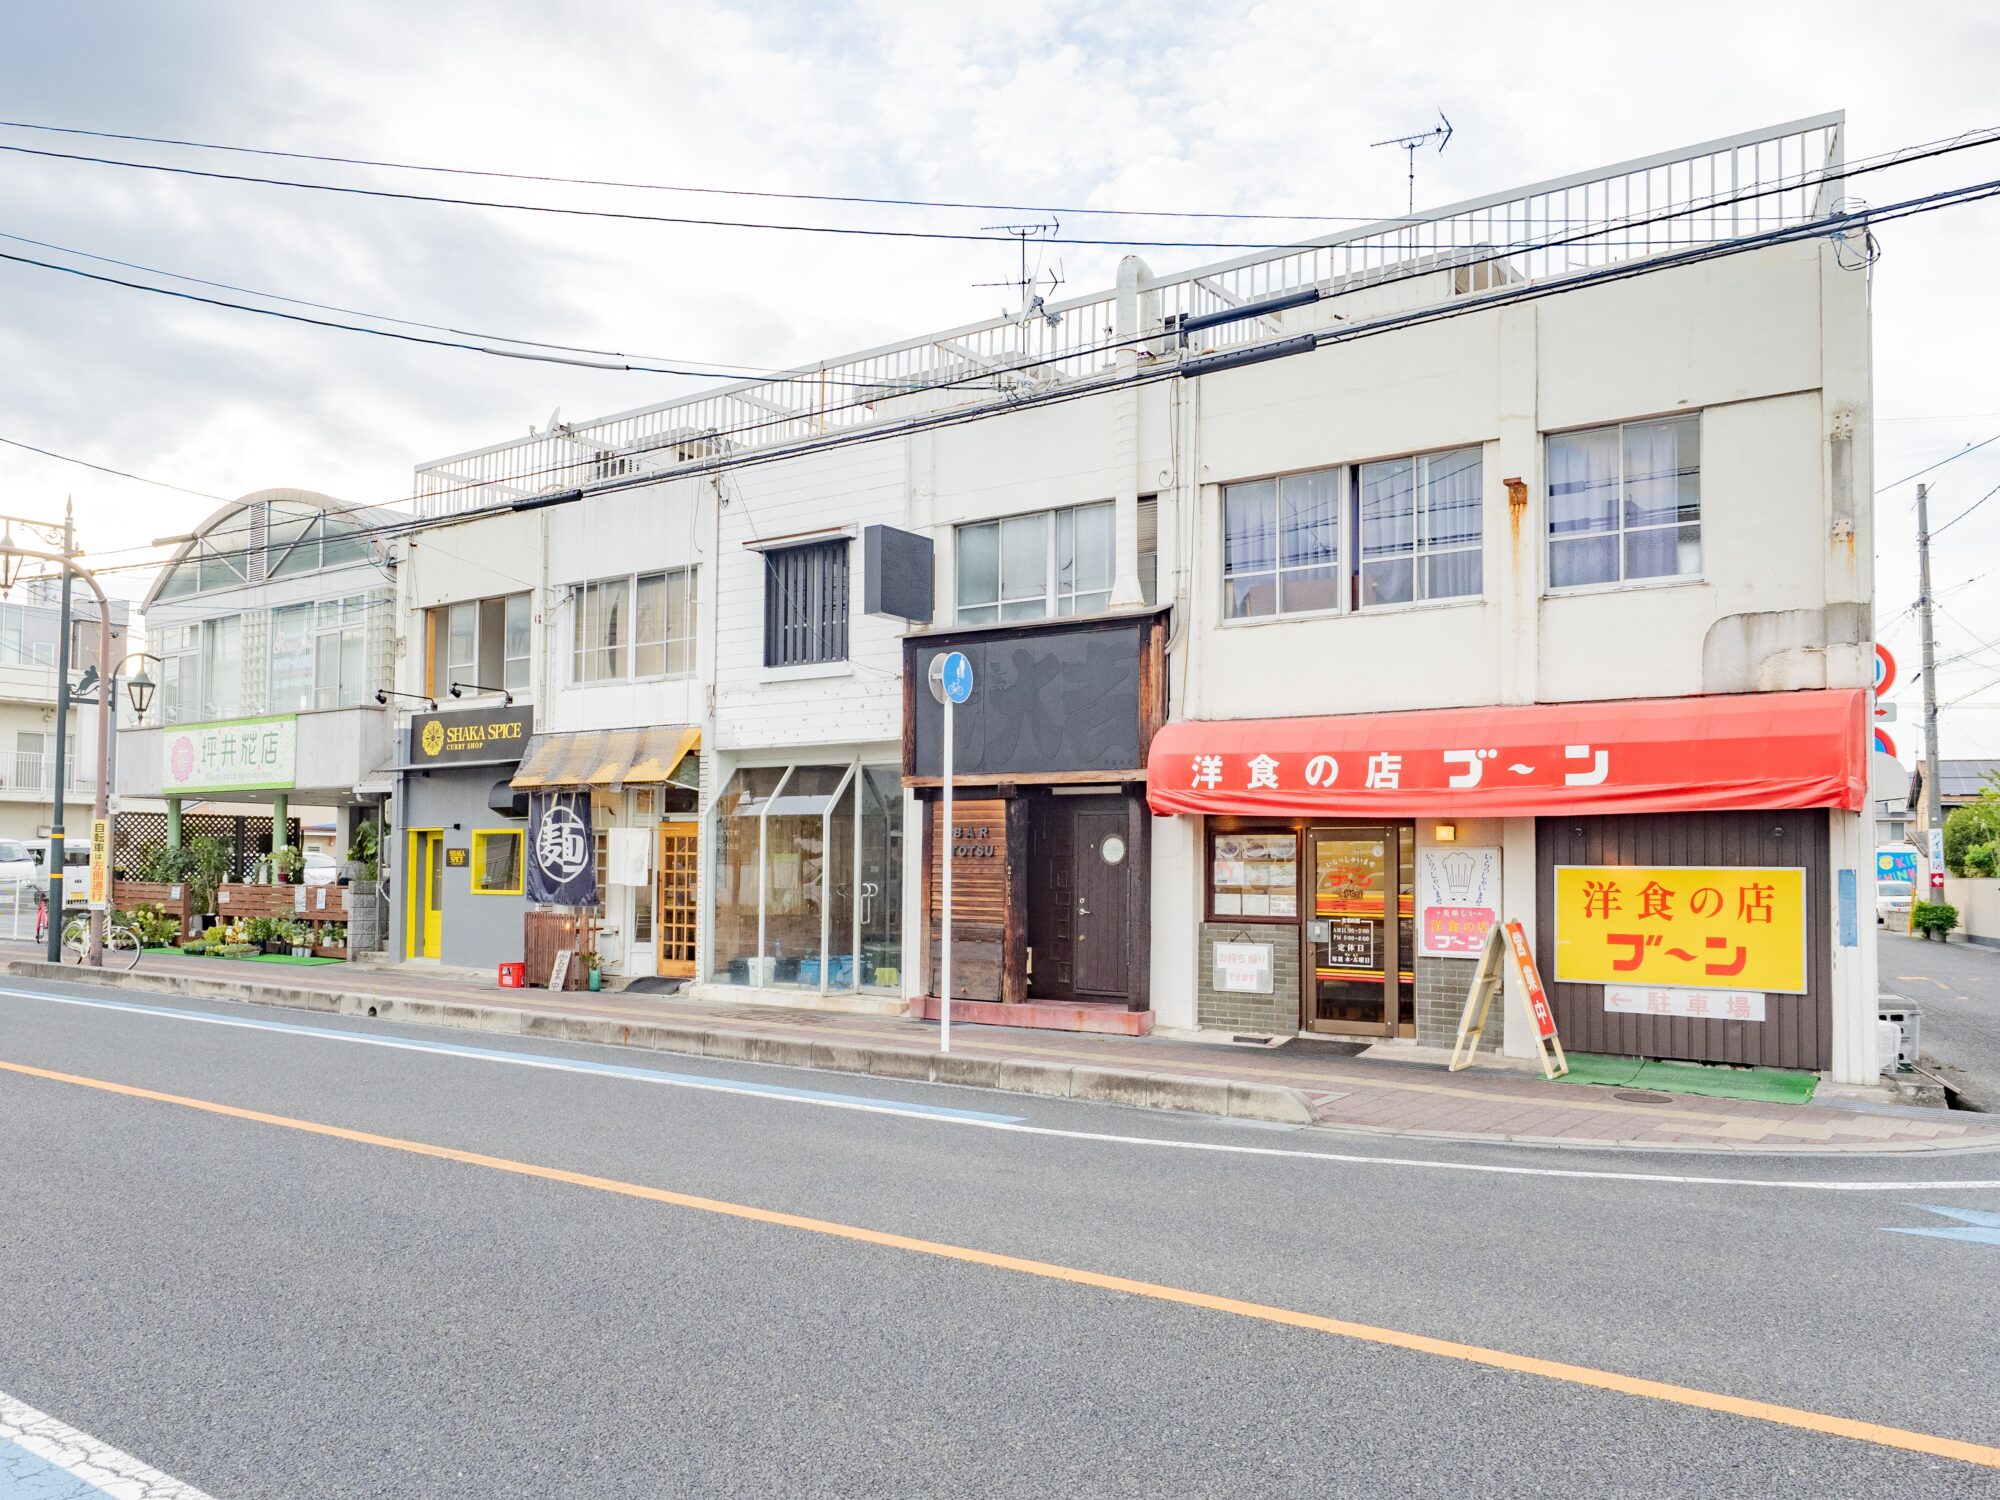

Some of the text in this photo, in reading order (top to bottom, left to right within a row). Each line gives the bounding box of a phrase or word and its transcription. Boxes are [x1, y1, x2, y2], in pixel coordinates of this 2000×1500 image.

[446, 723, 522, 742] SHAKA SPICE
[201, 730, 279, 768] 坪井花店
[446, 743, 465, 751] CURRY
[1191, 751, 1402, 789] 洋食の店
[954, 827, 989, 839] BAR
[92, 823, 105, 901] 自転車は左側通行
[1583, 880, 1774, 923] 洋食の店
[1430, 920, 1488, 933] 洋食の店
[1338, 943, 1364, 952] 定休日
[1646, 992, 1752, 1019] 駐車場
